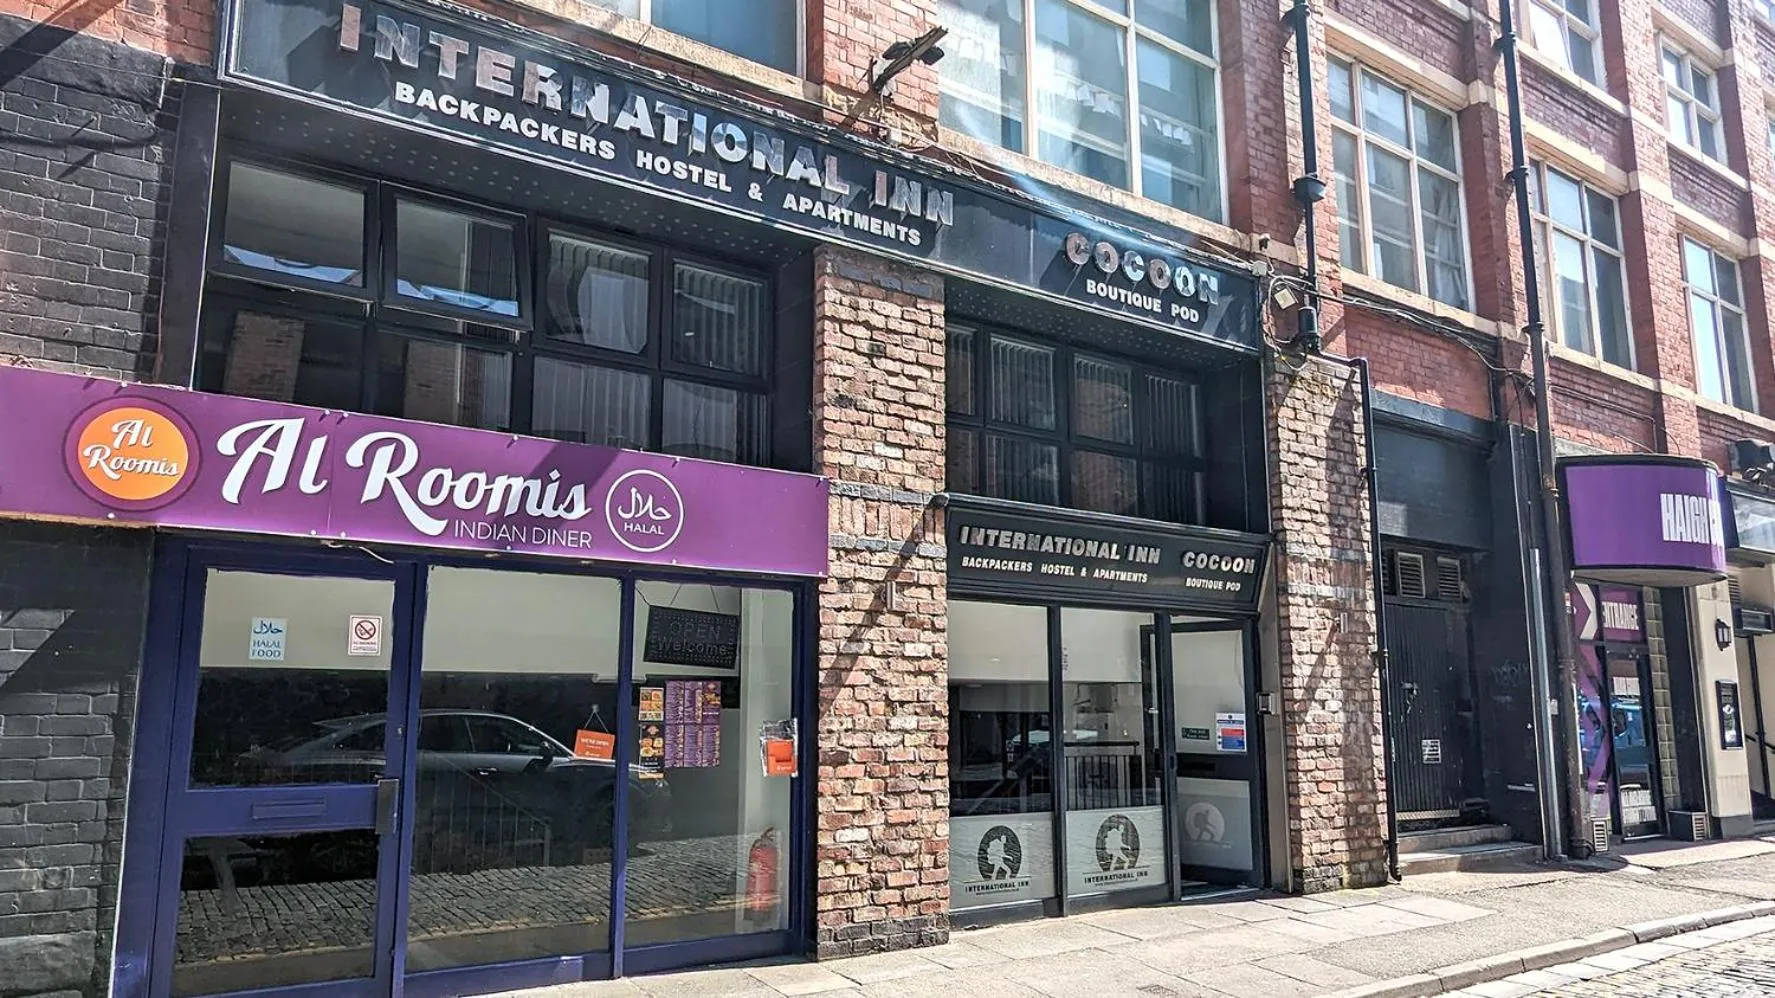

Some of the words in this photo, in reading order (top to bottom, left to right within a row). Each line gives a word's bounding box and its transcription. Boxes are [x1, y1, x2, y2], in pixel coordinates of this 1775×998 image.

[339, 3, 850, 195] INTERNATIONAL
[872, 170, 953, 227] INN
[395, 81, 616, 161] BACKPACKERS
[636, 150, 732, 193] HOSTEL
[748, 182, 764, 201] &
[783, 193, 922, 246] APARTMENTS
[1066, 232, 1219, 305] COCOON
[1086, 279, 1162, 313] BOUTIQUE
[1171, 302, 1200, 323] POD
[111, 418, 153, 449] Al
[83, 444, 180, 481] Roomis
[216, 417, 328, 504] Al
[346, 431, 592, 536] Roomis
[617, 486, 672, 521] حلال
[454, 520, 527, 543] INDIAN
[532, 527, 593, 549] DINER
[623, 521, 665, 535] HALAL
[960, 526, 1120, 560] INTERNATIONAL
[1127, 546, 1161, 564] INN
[961, 556, 1033, 573] BACKPACKERS
[1041, 562, 1075, 576] HOSTEL
[1080, 567, 1087, 577] &
[1093, 567, 1148, 583] APARTMENTS
[1183, 551, 1255, 574] COCOON
[1185, 577, 1223, 590] BOUTIQUE
[1226, 581, 1241, 591] POD
[253, 620, 283, 634] حلال
[670, 621, 721, 640] OPEN
[252, 649, 281, 657] FOOD
[253, 639, 281, 648] HALAL
[657, 636, 729, 655] Welcome
[965, 881, 1016, 893] INTERNATIONAL
